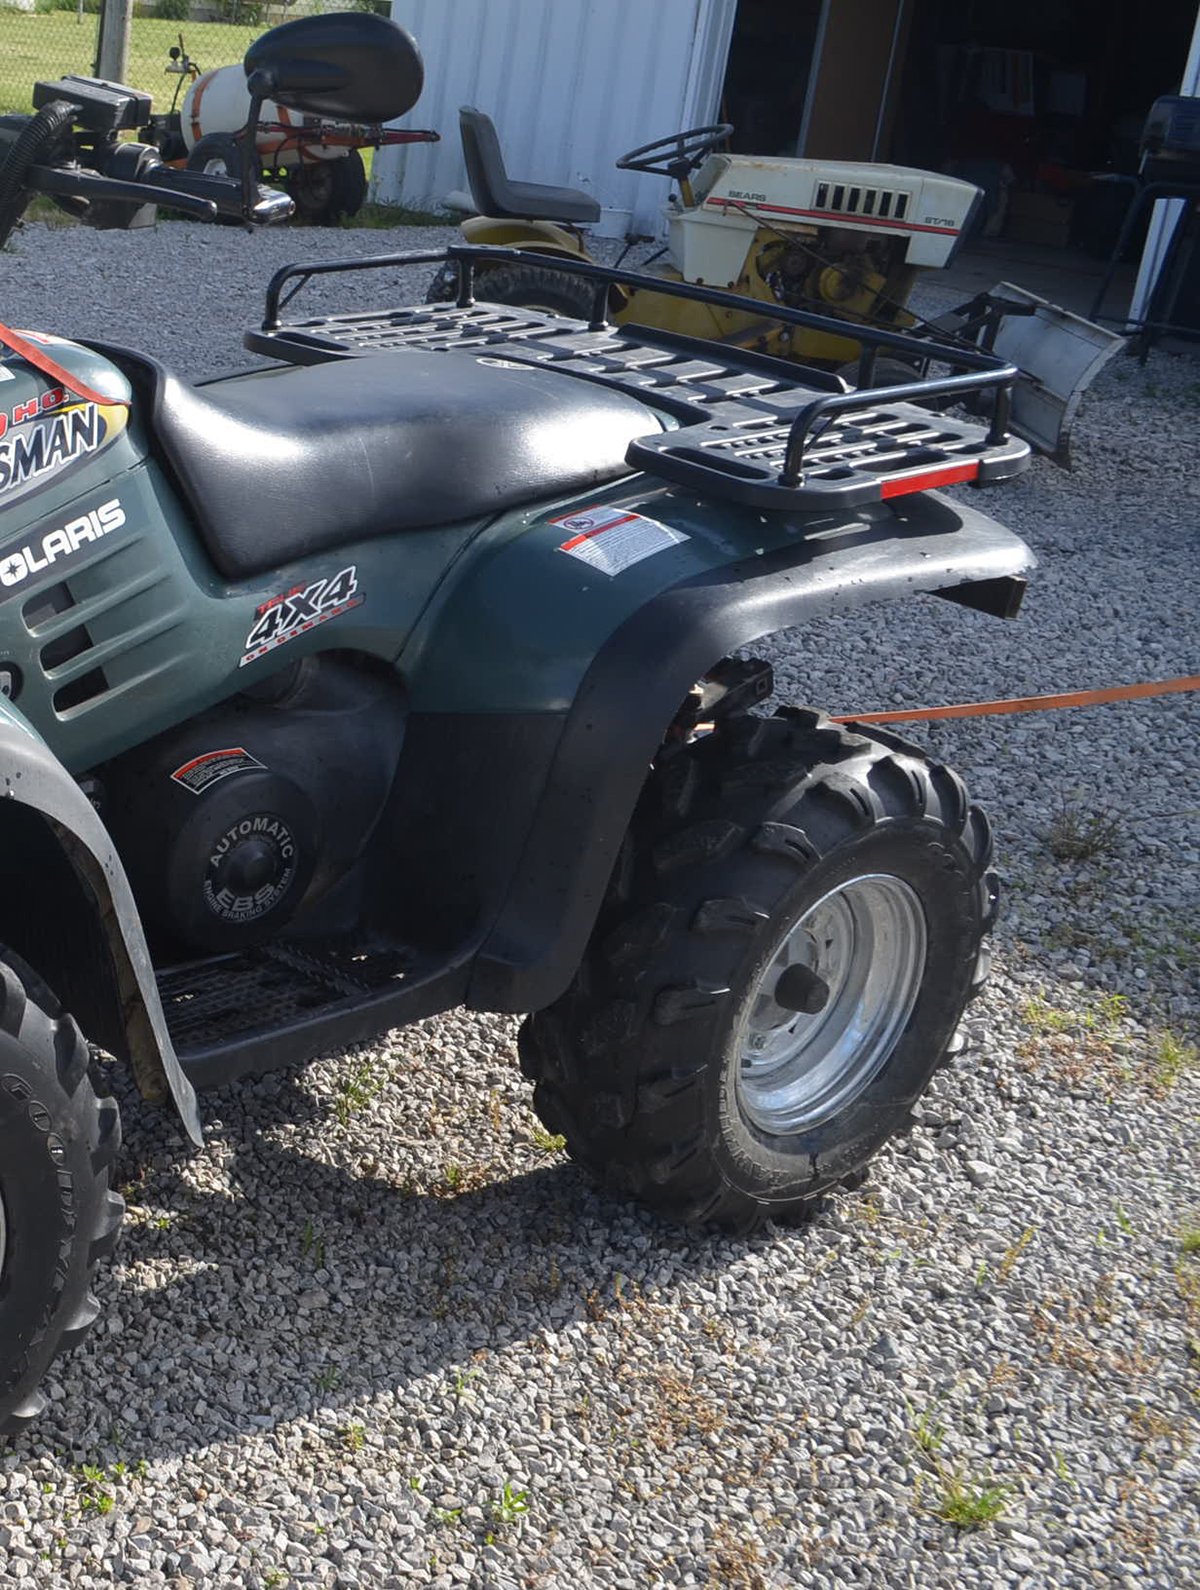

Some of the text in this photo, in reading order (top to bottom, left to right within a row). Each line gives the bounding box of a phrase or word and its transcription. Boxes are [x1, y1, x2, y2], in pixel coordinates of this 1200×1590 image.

[728, 189, 767, 202] SEARS
[245, 565, 358, 650] 4X4
[275, 597, 360, 644] DEMAND
[210, 817, 294, 868] AUTOMATIC
[215, 883, 275, 912] EBS
[221, 904, 263, 921] BRAKING
[264, 867, 292, 907] SYSTEM
